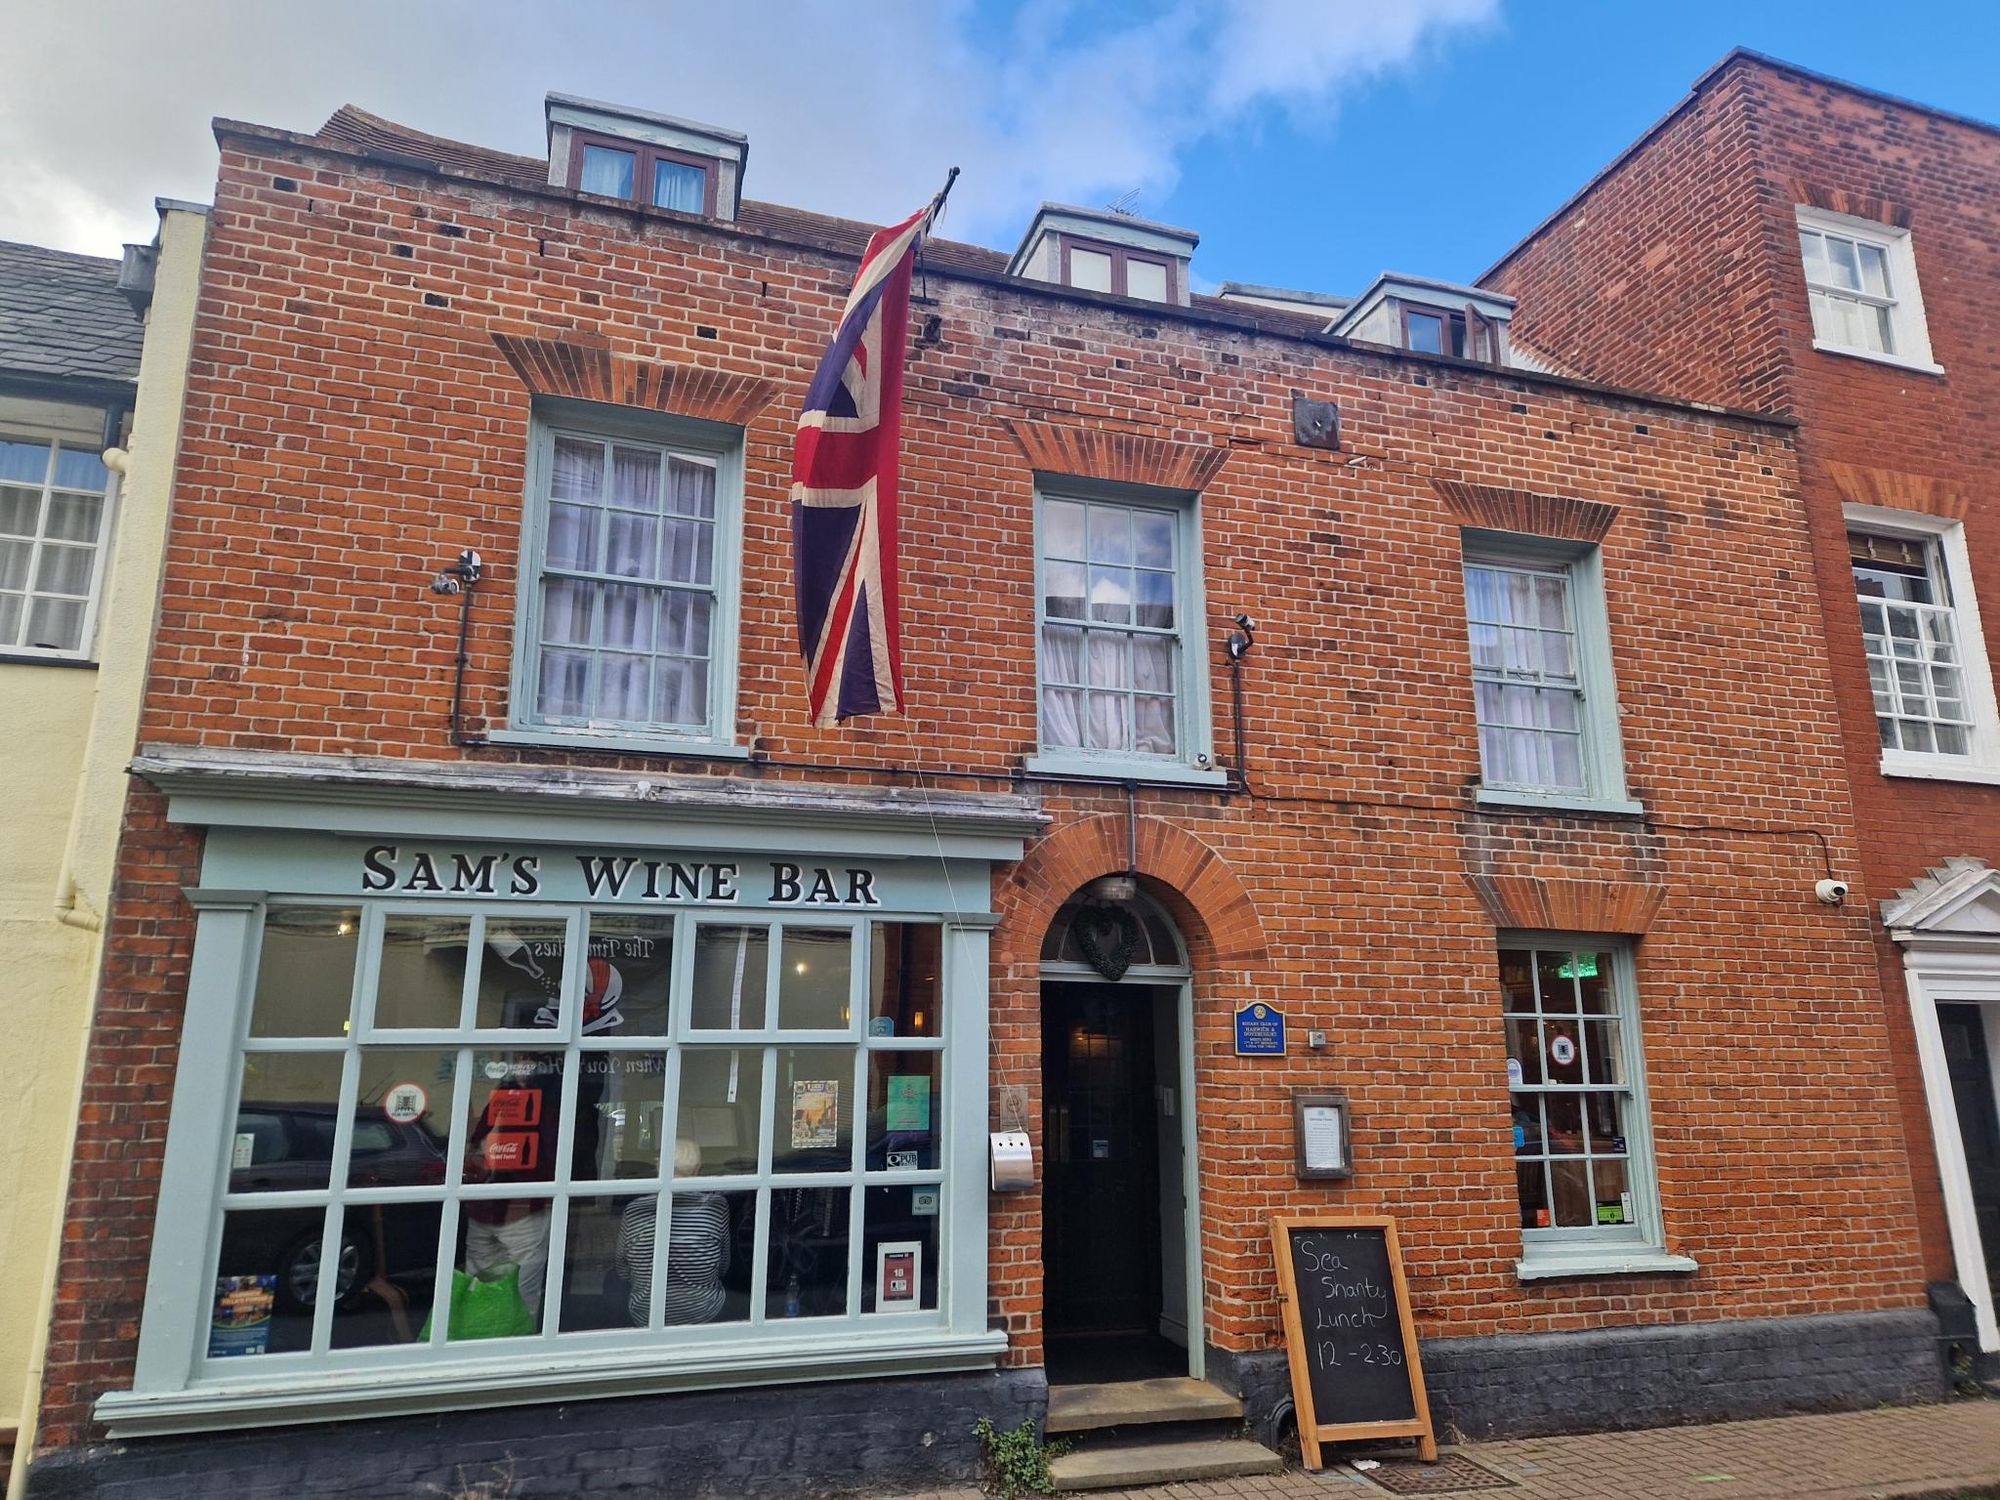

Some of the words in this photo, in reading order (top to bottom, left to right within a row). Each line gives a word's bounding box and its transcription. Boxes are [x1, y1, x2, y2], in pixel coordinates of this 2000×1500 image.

[362, 845, 540, 896] SAM'S
[575, 855, 740, 902] WINE
[768, 862, 881, 906] BAR
[901, 1154, 917, 1163] PUB
[1301, 1241, 1349, 1272] Sea
[1321, 1276, 1387, 1318] Shanty
[1317, 1306, 1376, 1329] Lunch
[1317, 1341, 1341, 1370] 12
